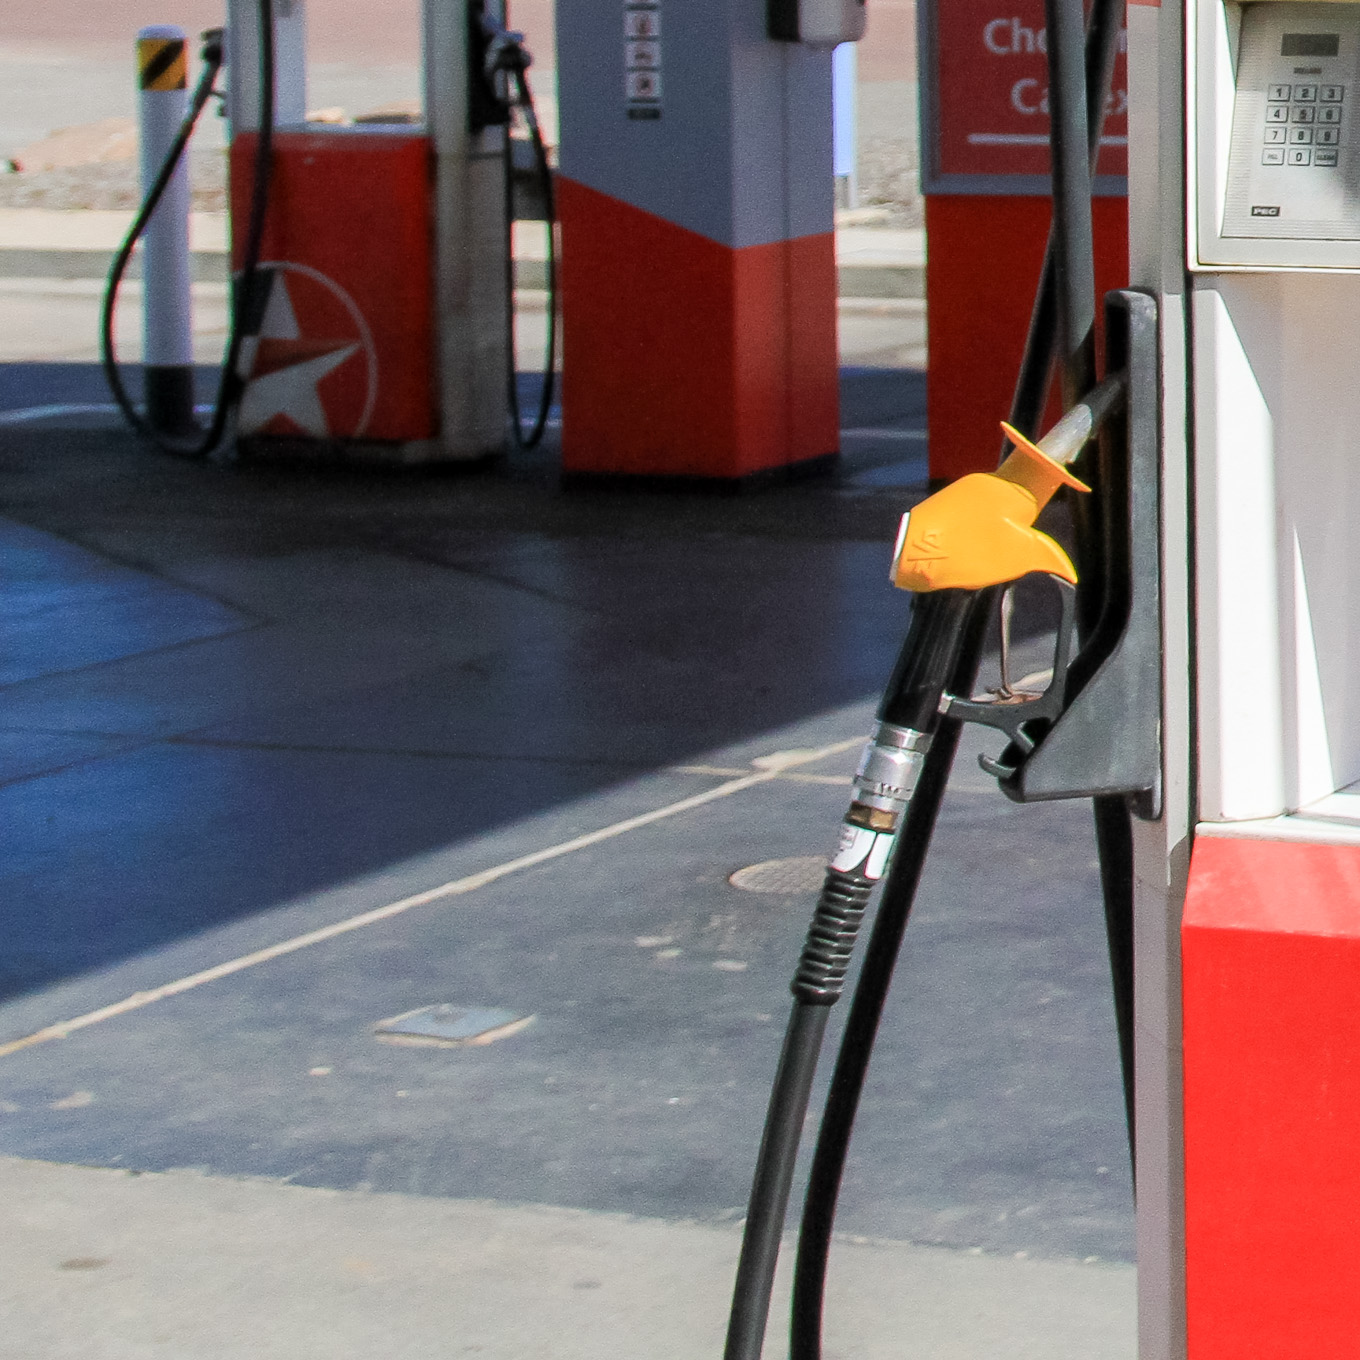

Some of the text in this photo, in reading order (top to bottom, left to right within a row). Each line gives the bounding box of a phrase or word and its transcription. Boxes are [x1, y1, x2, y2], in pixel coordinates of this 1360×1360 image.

[1276, 88, 1335, 98] 1 2 3
[1273, 109, 1281, 118] 4
[1300, 109, 1307, 119] 5
[1272, 131, 1278, 140] 7
[1295, 152, 1303, 162] 0
[1253, 207, 1278, 215] PEC
